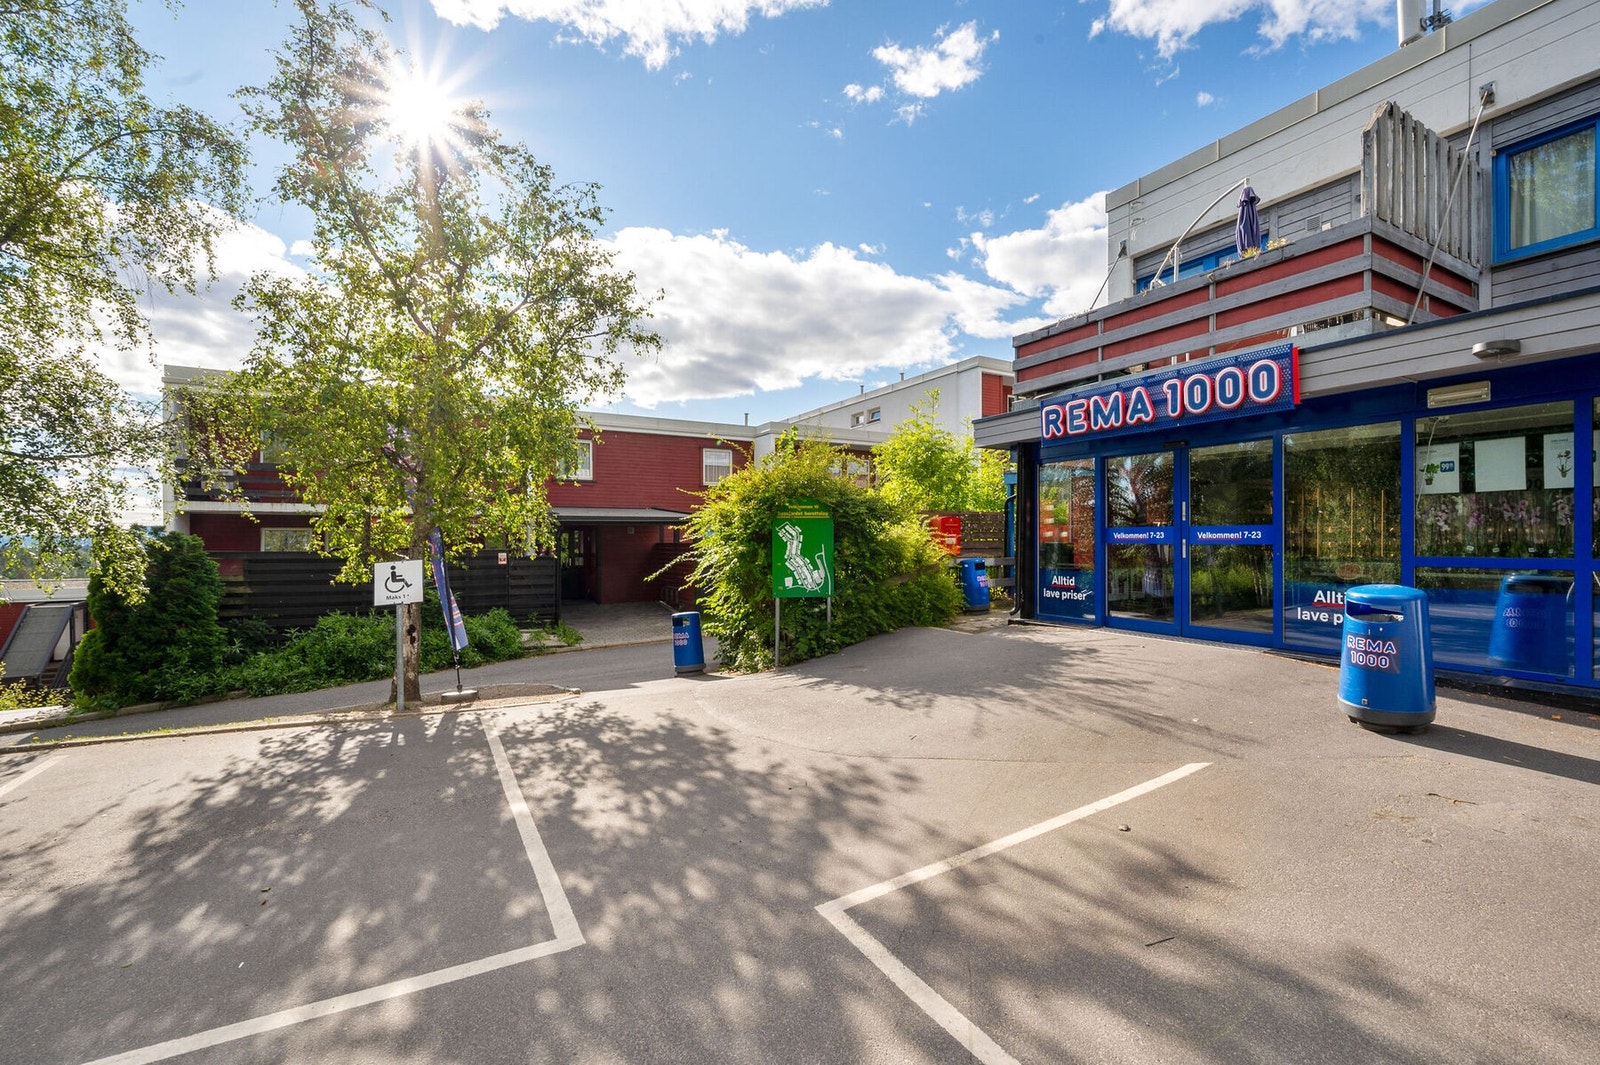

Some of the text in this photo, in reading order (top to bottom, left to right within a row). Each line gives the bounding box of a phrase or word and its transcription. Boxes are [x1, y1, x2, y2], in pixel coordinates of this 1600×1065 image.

[1042, 359, 1282, 439] REMA 1000
[1150, 531, 1165, 539] 7-23
[1198, 531, 1262, 539] Velkommen! 7-23
[1052, 575, 1075, 586] Alltid
[1043, 588, 1086, 600] lave priser
[1313, 590, 1347, 605] Allti
[1297, 607, 1329, 622] lave
[1346, 634, 1397, 655] REMA
[1350, 651, 1390, 669] 1000
